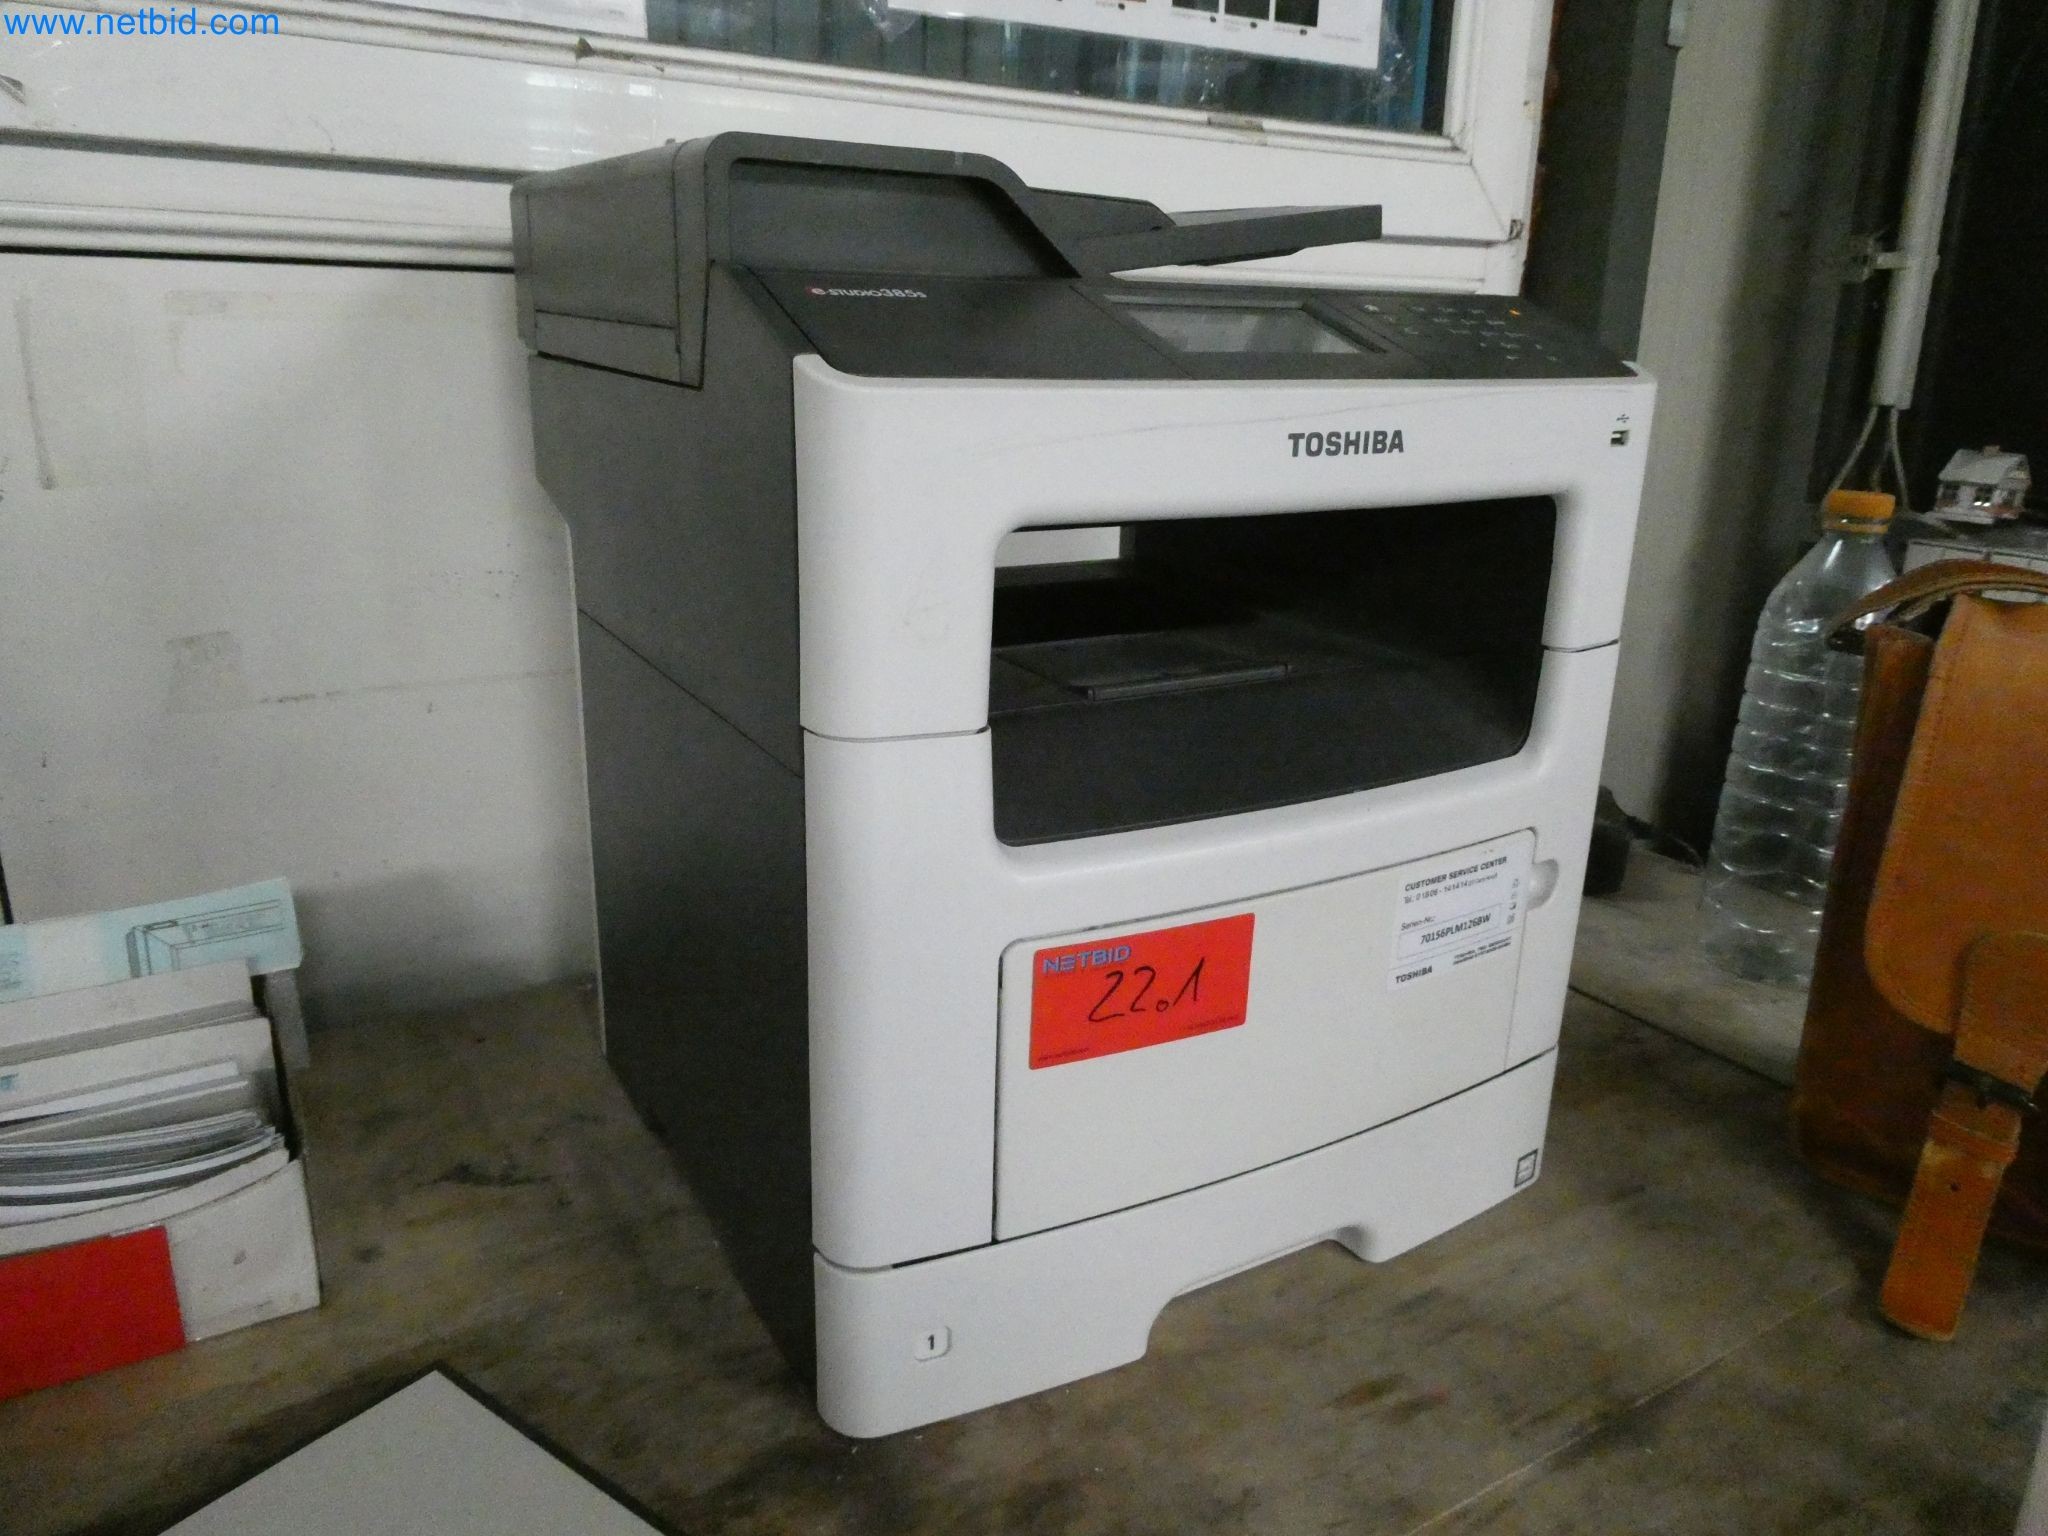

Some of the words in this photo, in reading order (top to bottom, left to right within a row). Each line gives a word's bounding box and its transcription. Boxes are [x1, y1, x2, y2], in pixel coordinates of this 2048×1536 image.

[1288, 429, 1404, 458] TOSHIBA
[1405, 874, 1447, 891] CUSTOMER
[1449, 865, 1478, 879] SERVICE
[1480, 857, 1507, 870] CENTER
[1042, 945, 1132, 974] NETBID
[1088, 956, 1206, 1022] 22.1
[1395, 965, 1433, 984] TOSHIBA
[928, 1334, 935, 1350] 1
